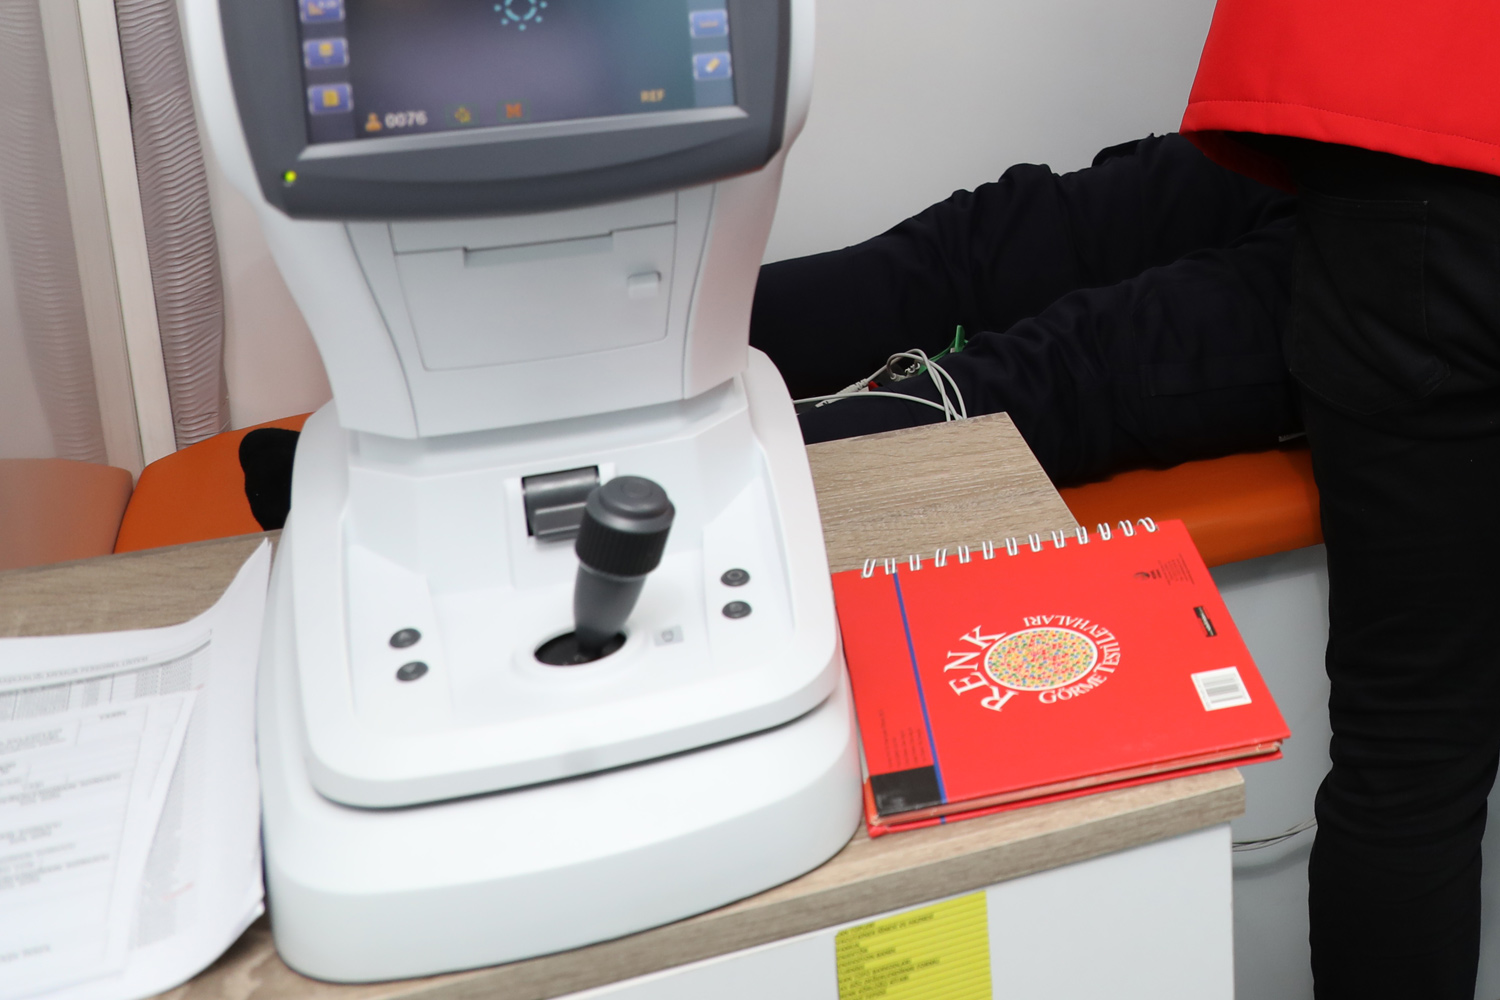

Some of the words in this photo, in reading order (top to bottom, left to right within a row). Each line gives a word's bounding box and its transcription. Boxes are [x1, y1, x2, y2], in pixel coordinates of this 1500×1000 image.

[385, 110, 428, 129] 0076
[1023, 614, 1116, 645] LEVHALARI
[943, 625, 1019, 712] RENK
[1038, 673, 1108, 704] GÖRME
